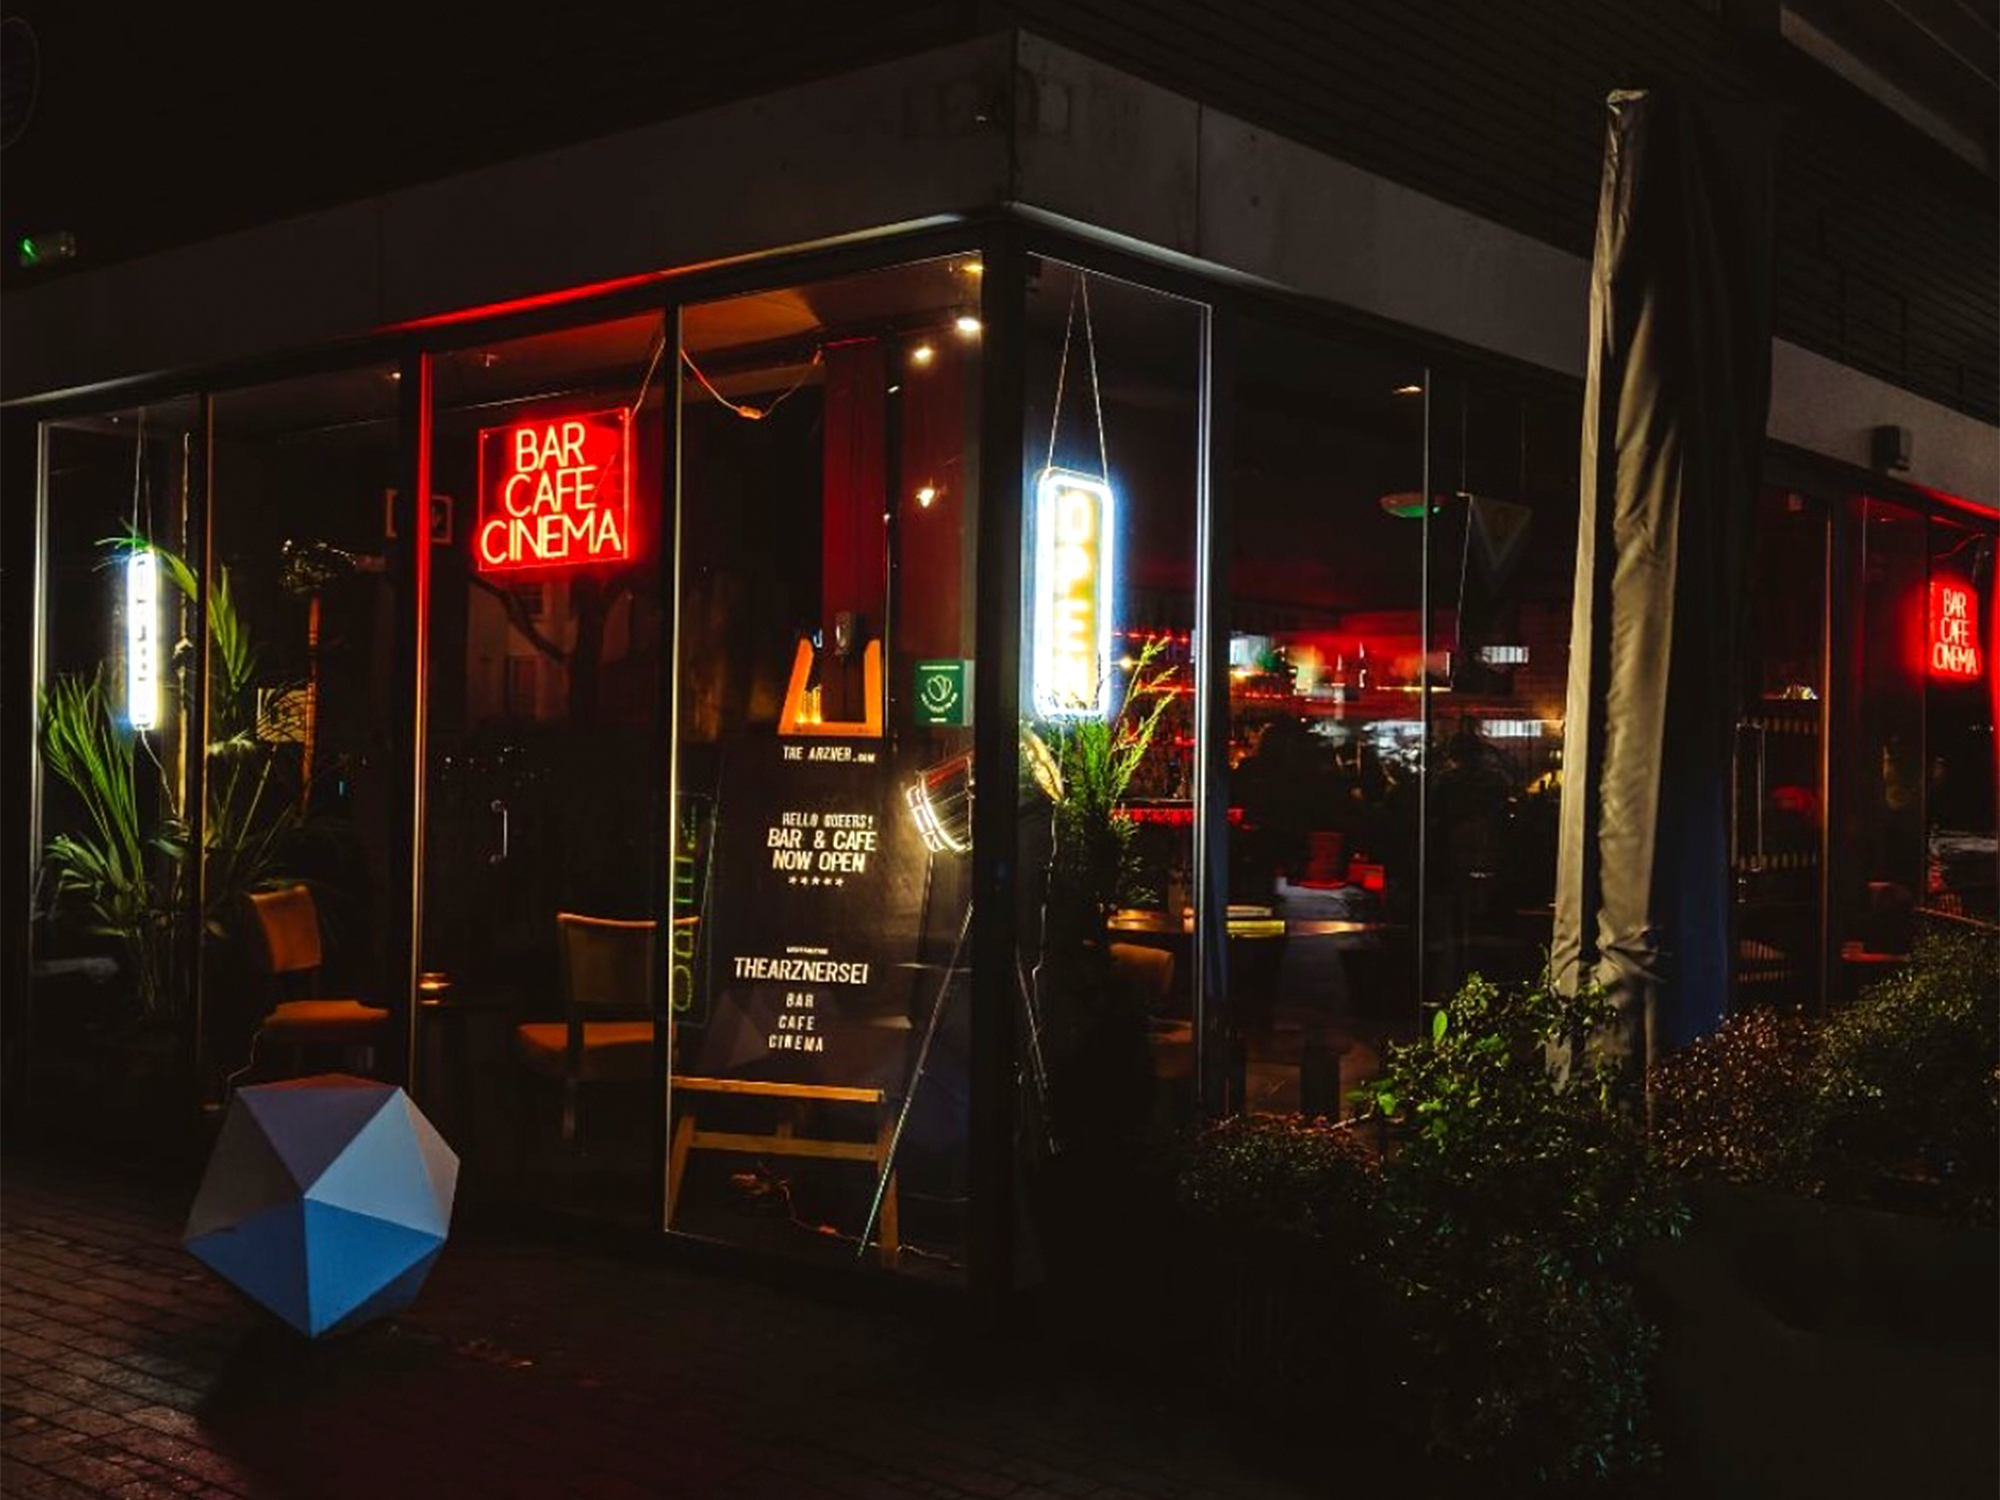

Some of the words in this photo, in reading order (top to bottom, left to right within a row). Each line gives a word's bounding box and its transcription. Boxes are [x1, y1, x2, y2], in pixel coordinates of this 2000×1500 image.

[515, 422, 585, 472] BAR
[505, 465, 597, 517] CAFE
[480, 508, 622, 564] CINEMA
[1942, 587, 1966, 619] BAR
[1941, 616, 1970, 647] CAFE
[1932, 641, 1978, 675] CINEMA
[783, 745, 804, 761] THE
[782, 812, 819, 828] HELLO
[767, 827, 802, 849] BAR
[813, 829, 825, 849] &
[833, 830, 878, 851] CAFE
[772, 849, 813, 870] NOW
[818, 851, 866, 873] OPEN
[786, 992, 814, 1008] BAR
[778, 1014, 815, 1031] CAFE
[768, 1034, 823, 1052] CINEMA
